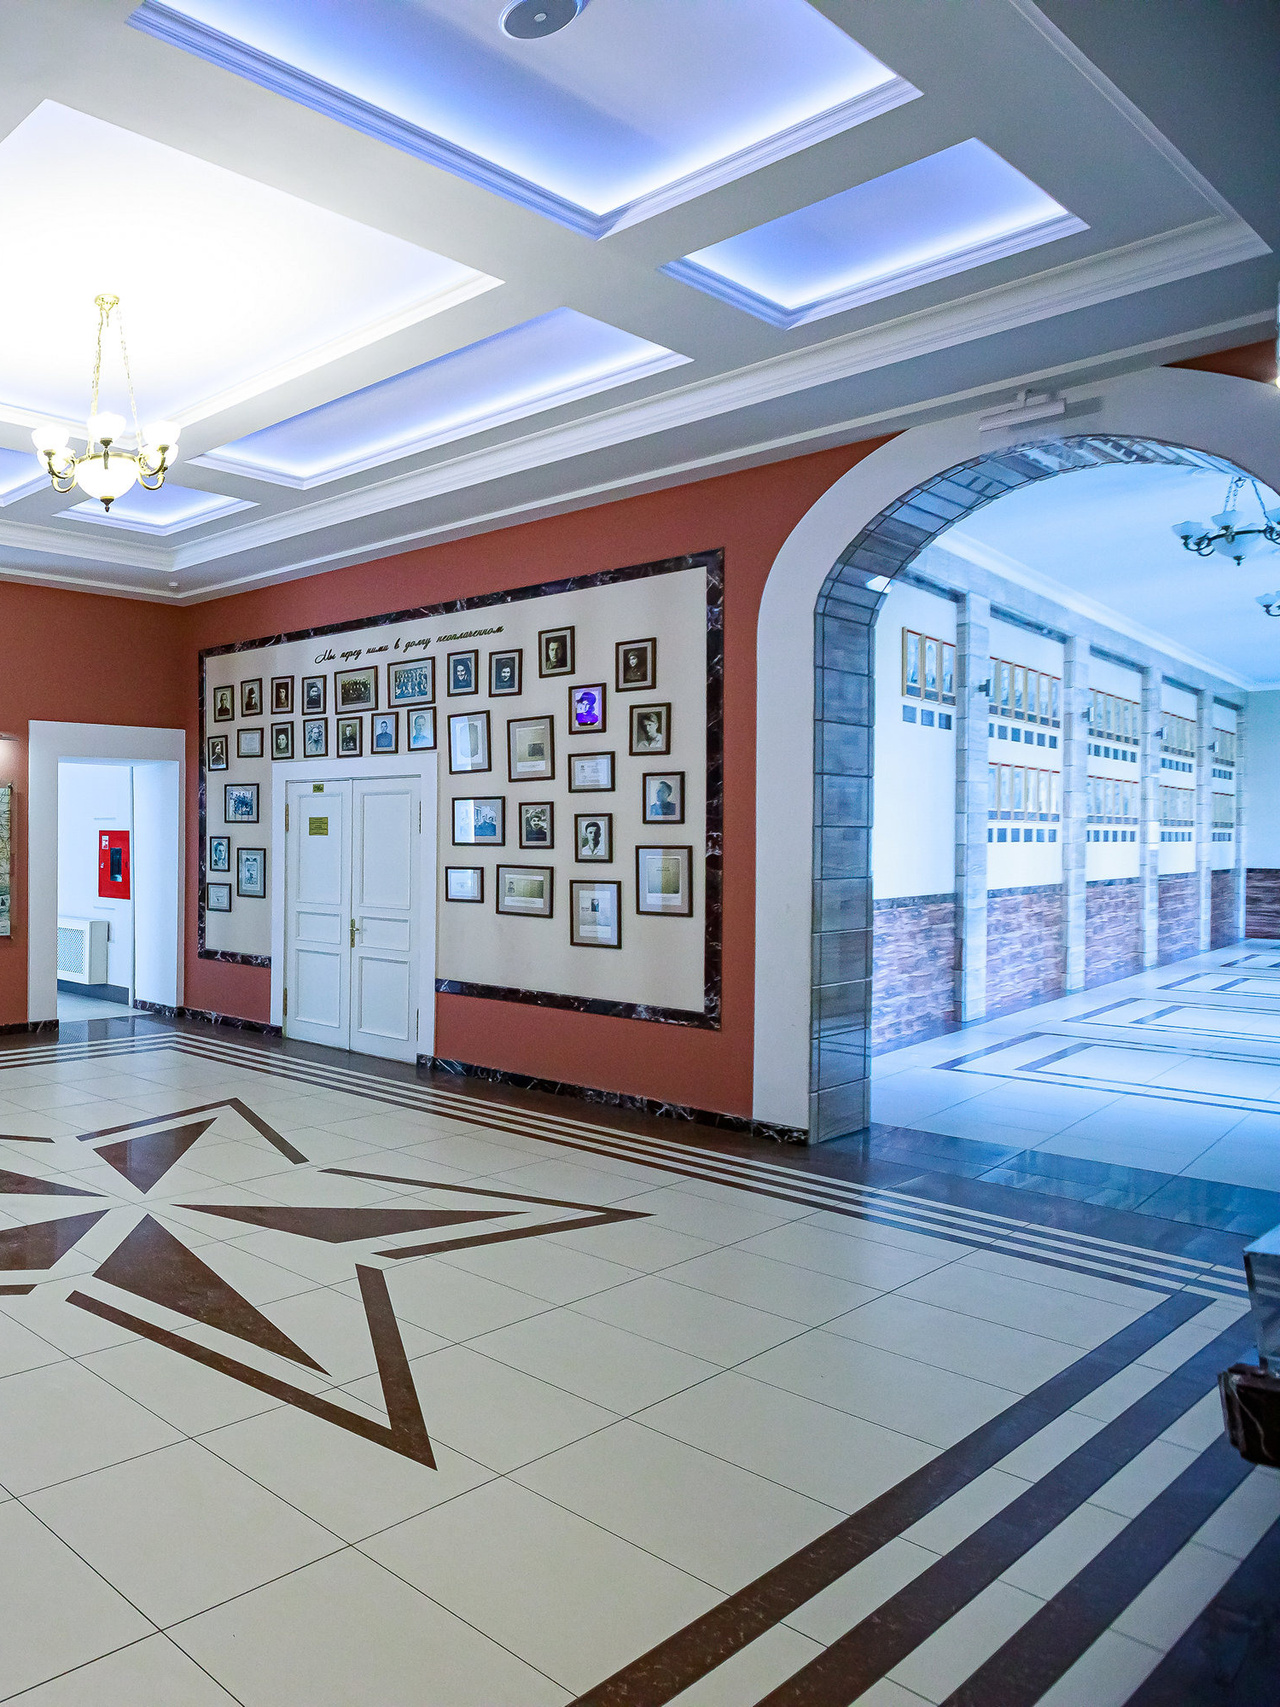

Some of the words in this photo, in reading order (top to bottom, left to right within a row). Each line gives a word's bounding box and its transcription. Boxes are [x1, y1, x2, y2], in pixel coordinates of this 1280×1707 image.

[315, 649, 336, 664] Мы
[340, 649, 362, 662] перед
[403, 638, 431, 653] долгу
